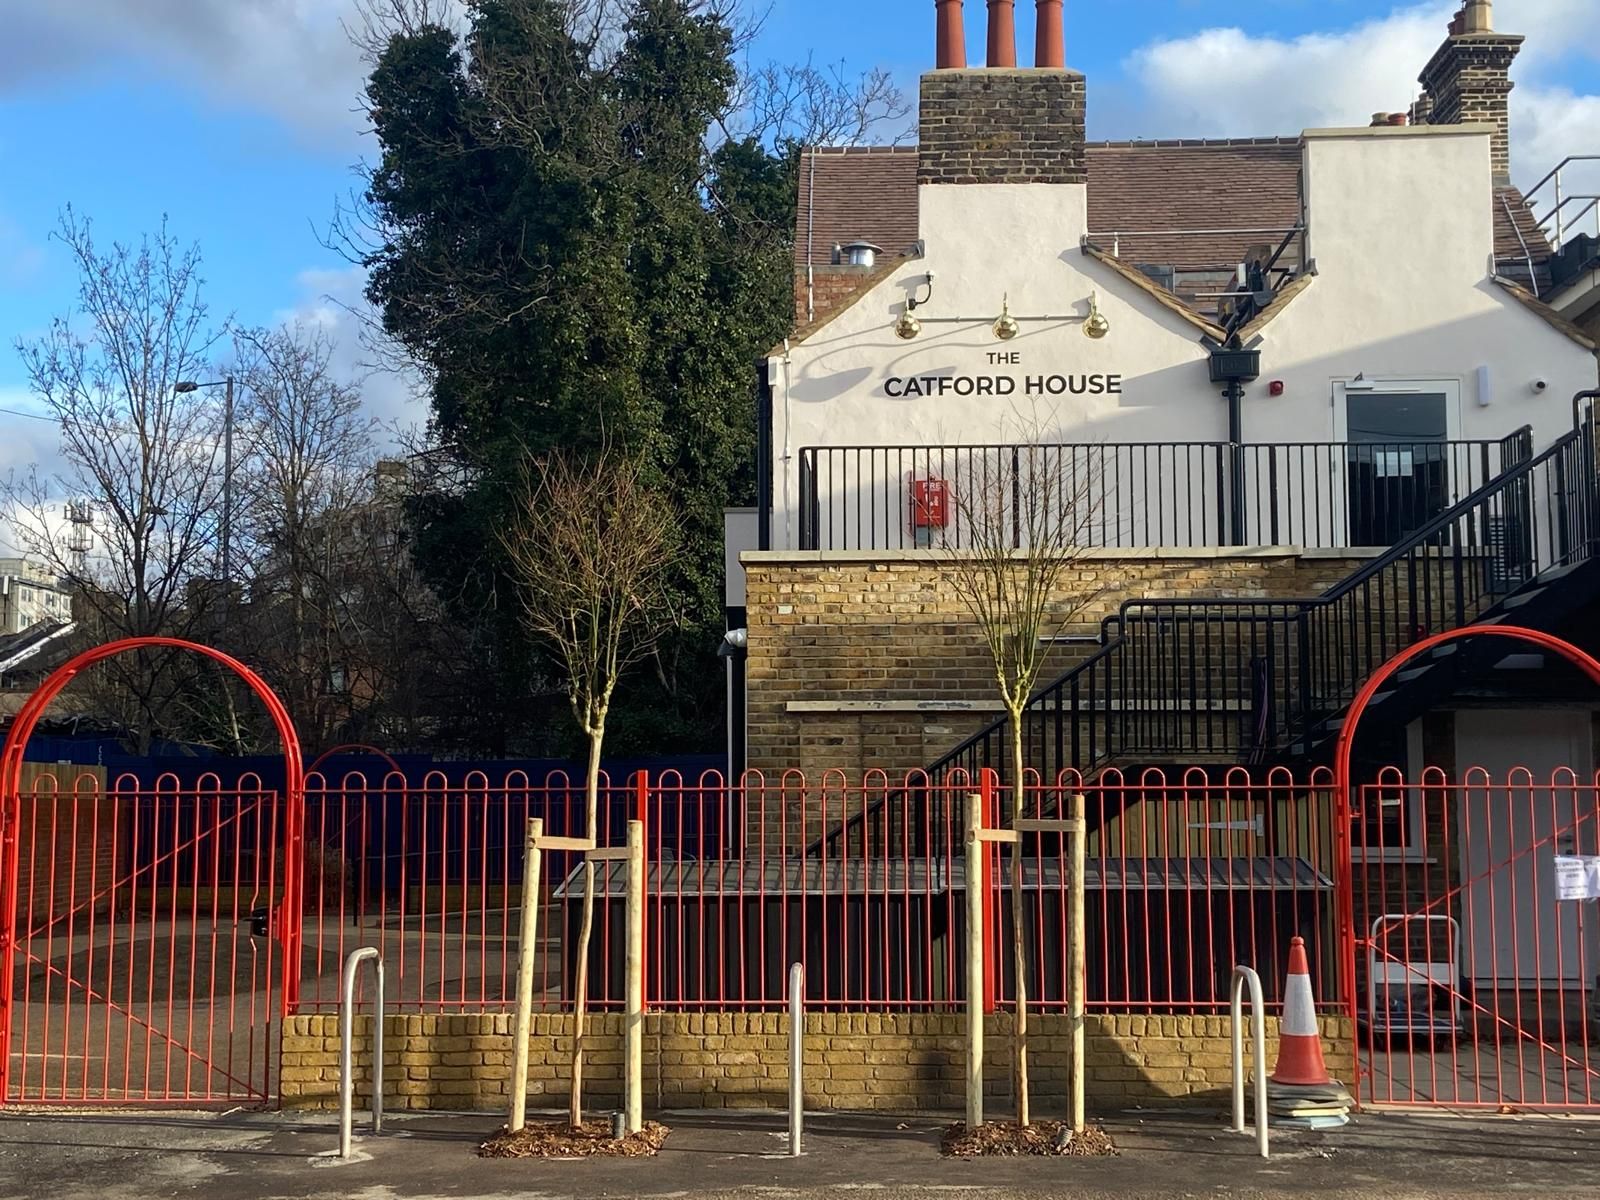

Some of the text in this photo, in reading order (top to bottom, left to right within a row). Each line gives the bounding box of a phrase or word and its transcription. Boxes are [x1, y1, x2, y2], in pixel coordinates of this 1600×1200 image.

[986, 352, 1020, 364] THE
[884, 374, 1122, 397] CATFORD HOUSE
